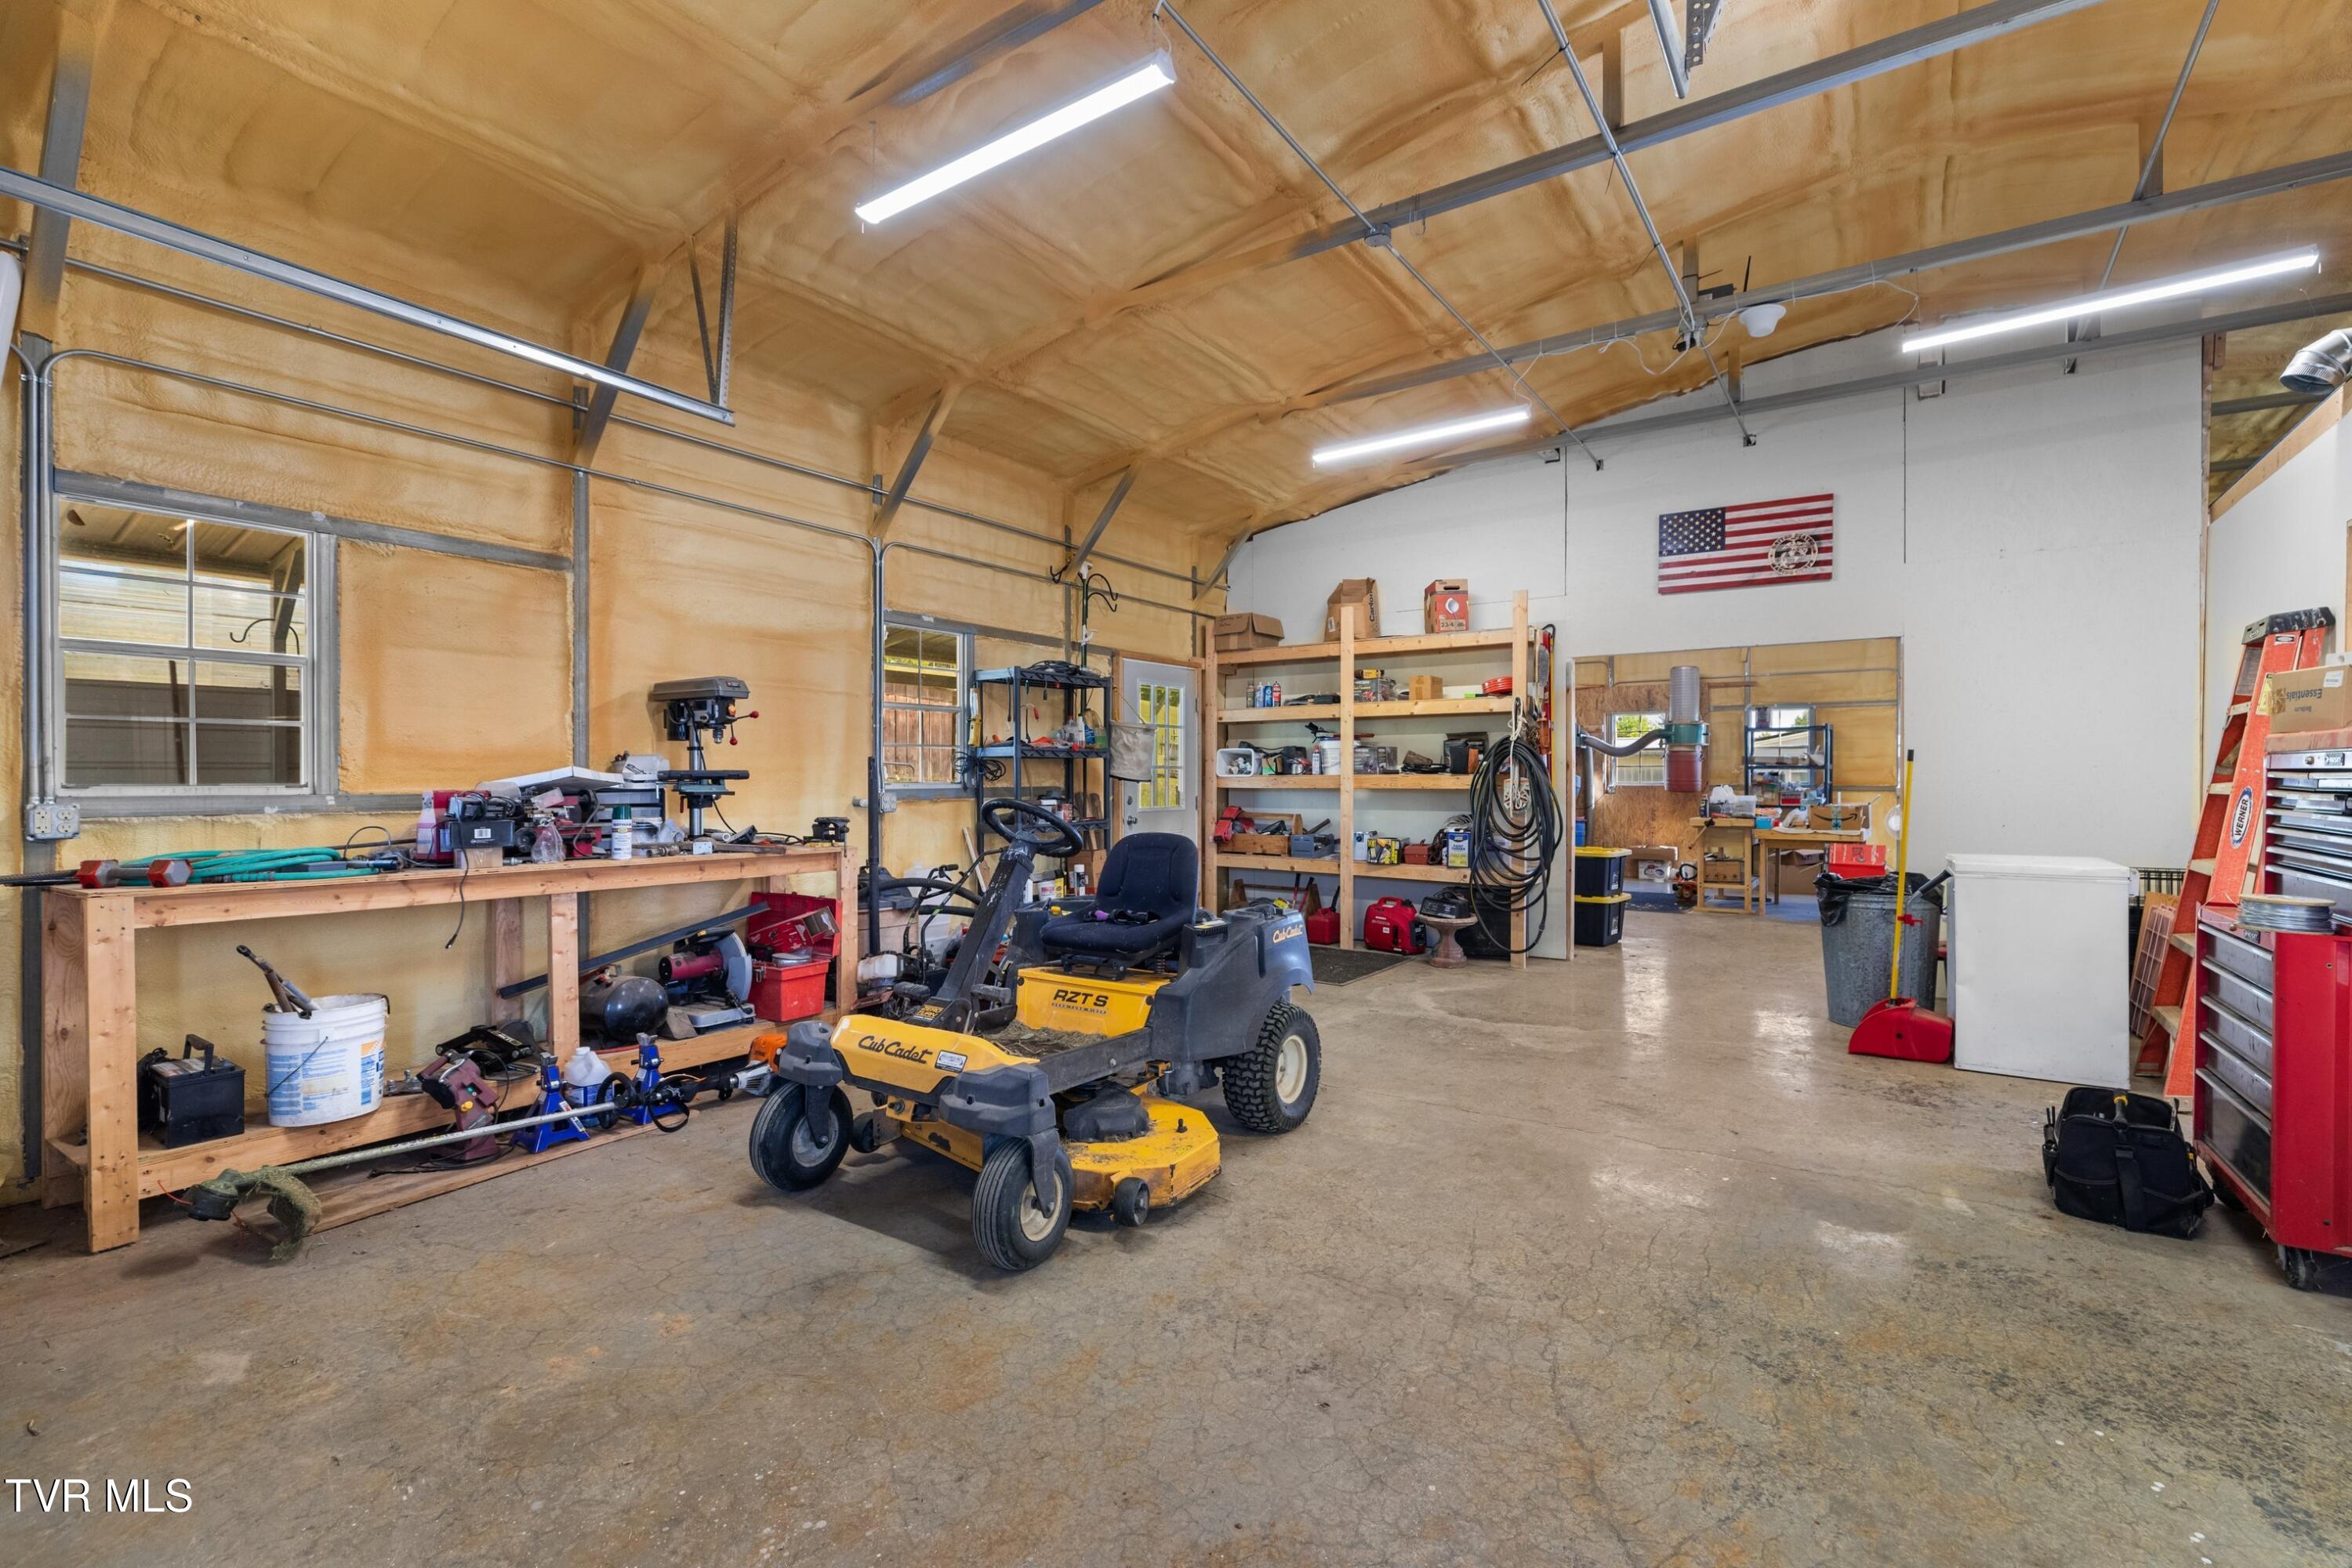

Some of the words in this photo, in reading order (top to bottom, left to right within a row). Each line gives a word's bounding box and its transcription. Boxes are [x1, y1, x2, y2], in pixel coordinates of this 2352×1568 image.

[2286, 688, 2323, 702] Essentials
[2234, 798, 2249, 837] WERNER
[1272, 928, 1286, 943] Cub
[1286, 924, 1304, 938] Cadet
[1053, 989, 1094, 1004] RZT
[1093, 994, 1109, 1007] S
[858, 1035, 886, 1053] Cub
[884, 1041, 933, 1065] Cadet
